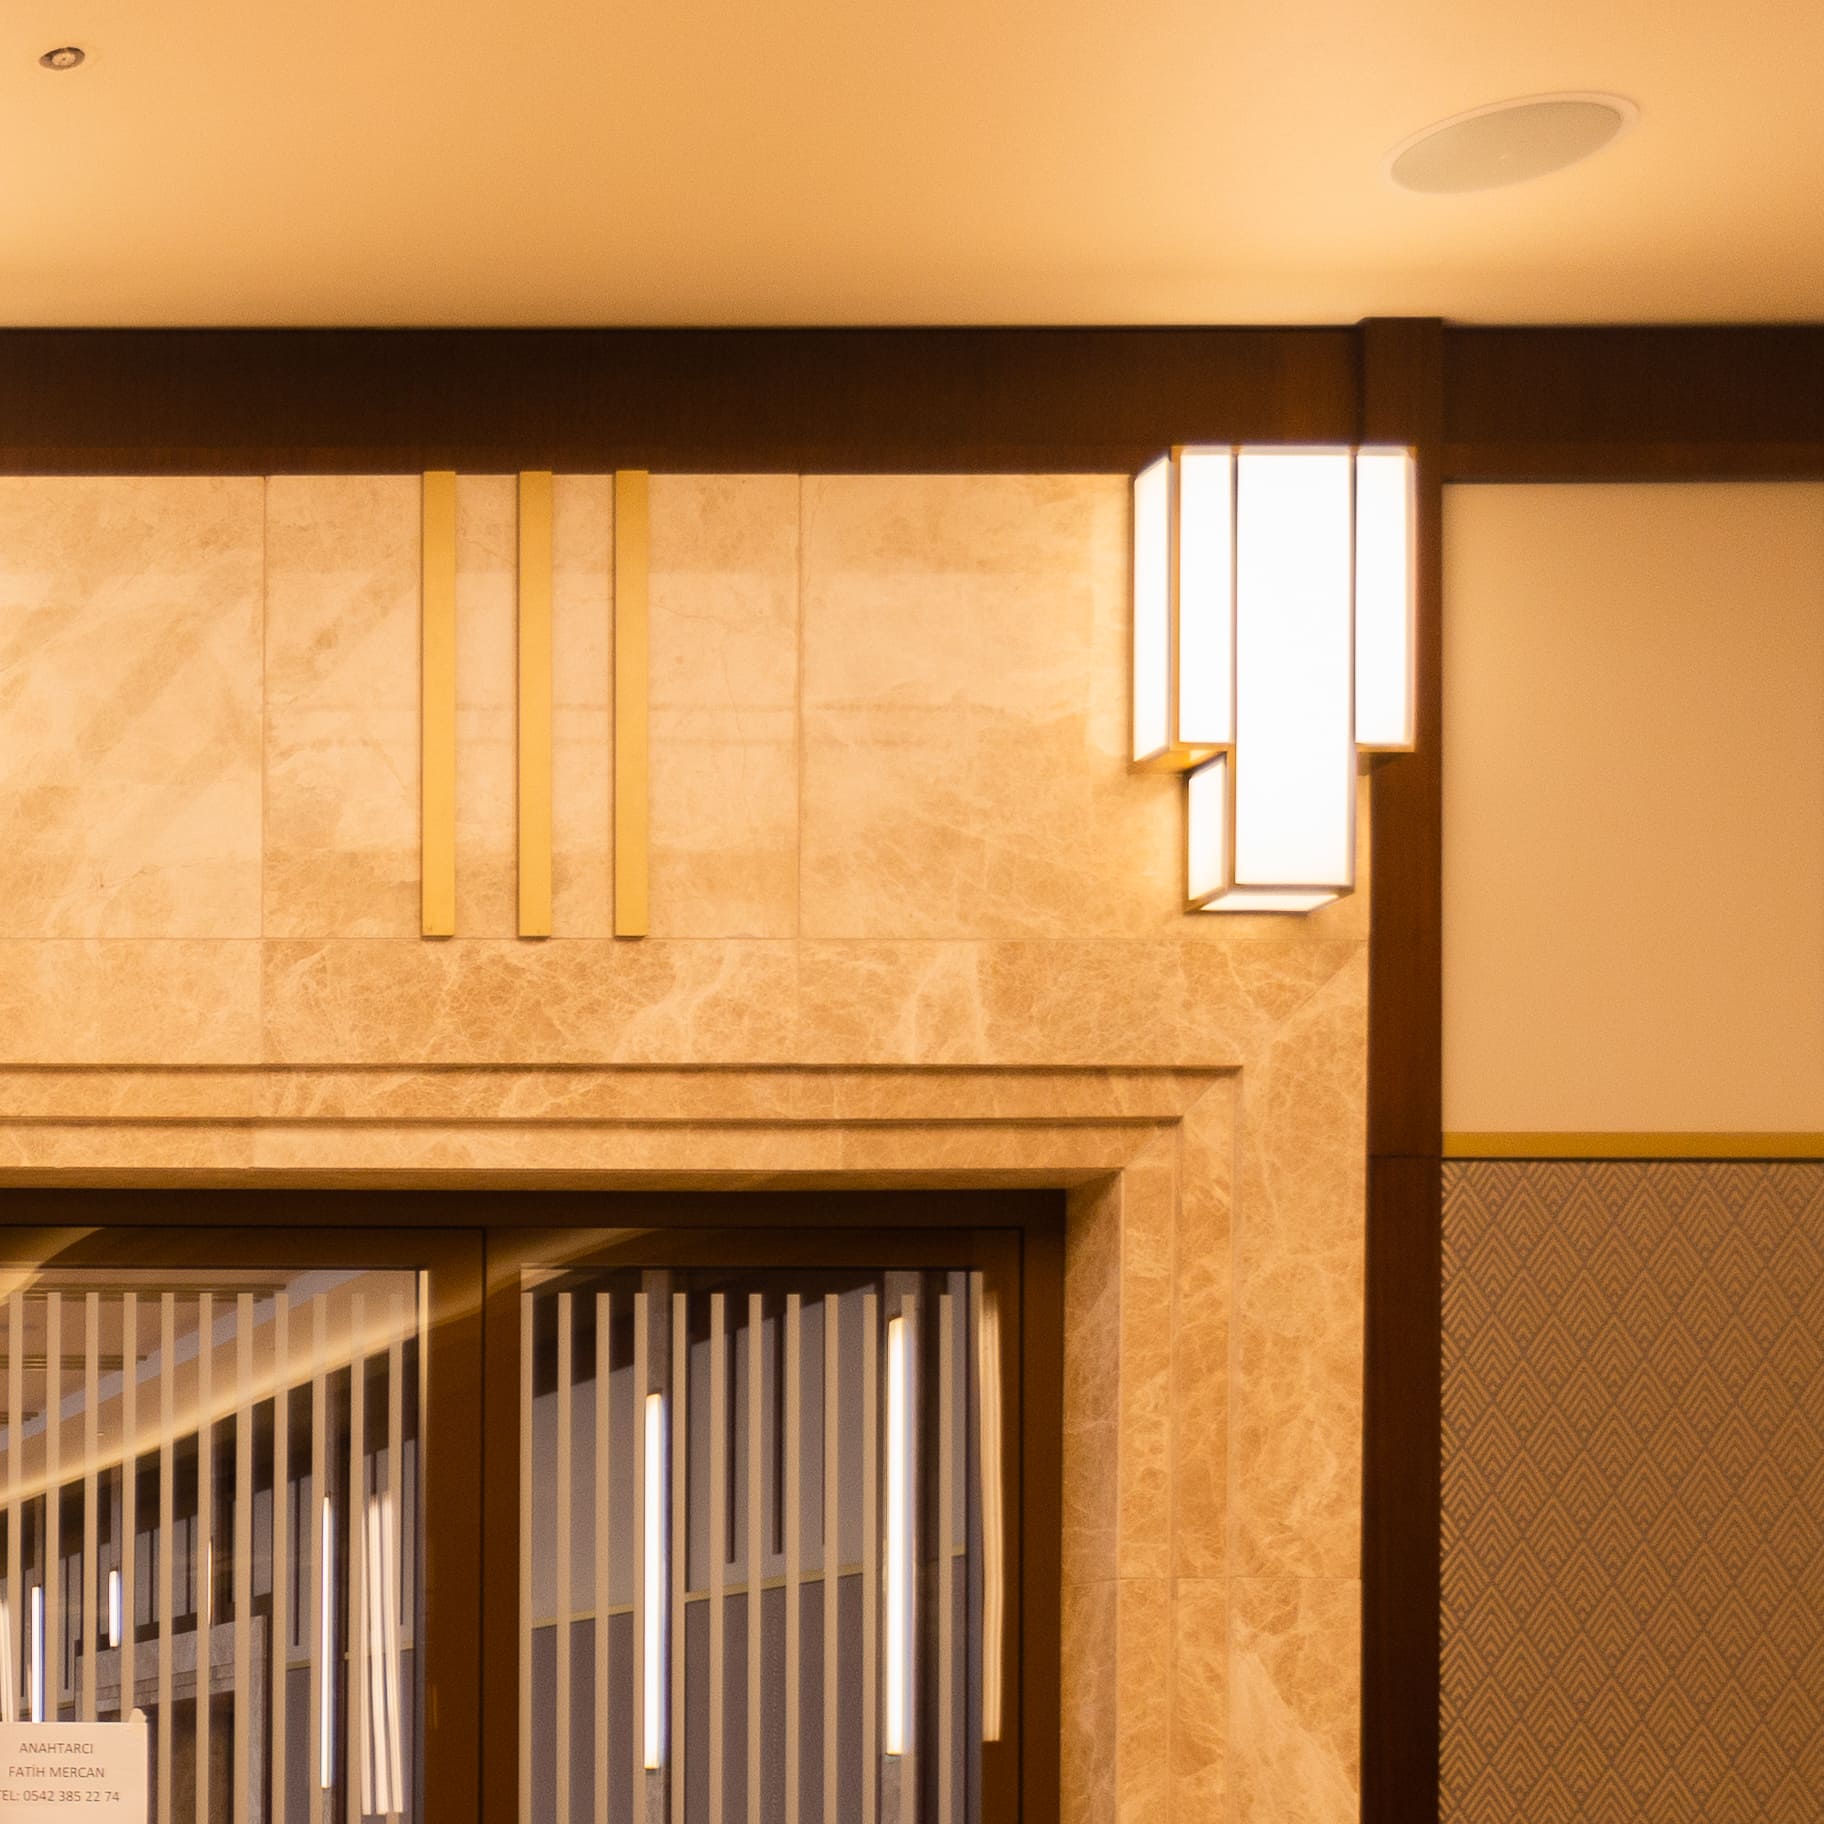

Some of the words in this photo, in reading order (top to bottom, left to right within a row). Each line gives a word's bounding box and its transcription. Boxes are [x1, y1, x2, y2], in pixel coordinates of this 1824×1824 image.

[19, 1743, 94, 1754] ANAHTARCI
[8, 1764, 45, 1777] FATİH
[49, 1767, 105, 1778] MERCAN
[23, 1790, 54, 1802] 0542
[58, 1791, 81, 1802] 385
[85, 1791, 101, 1802] 22
[104, 1791, 120, 1802] 74
